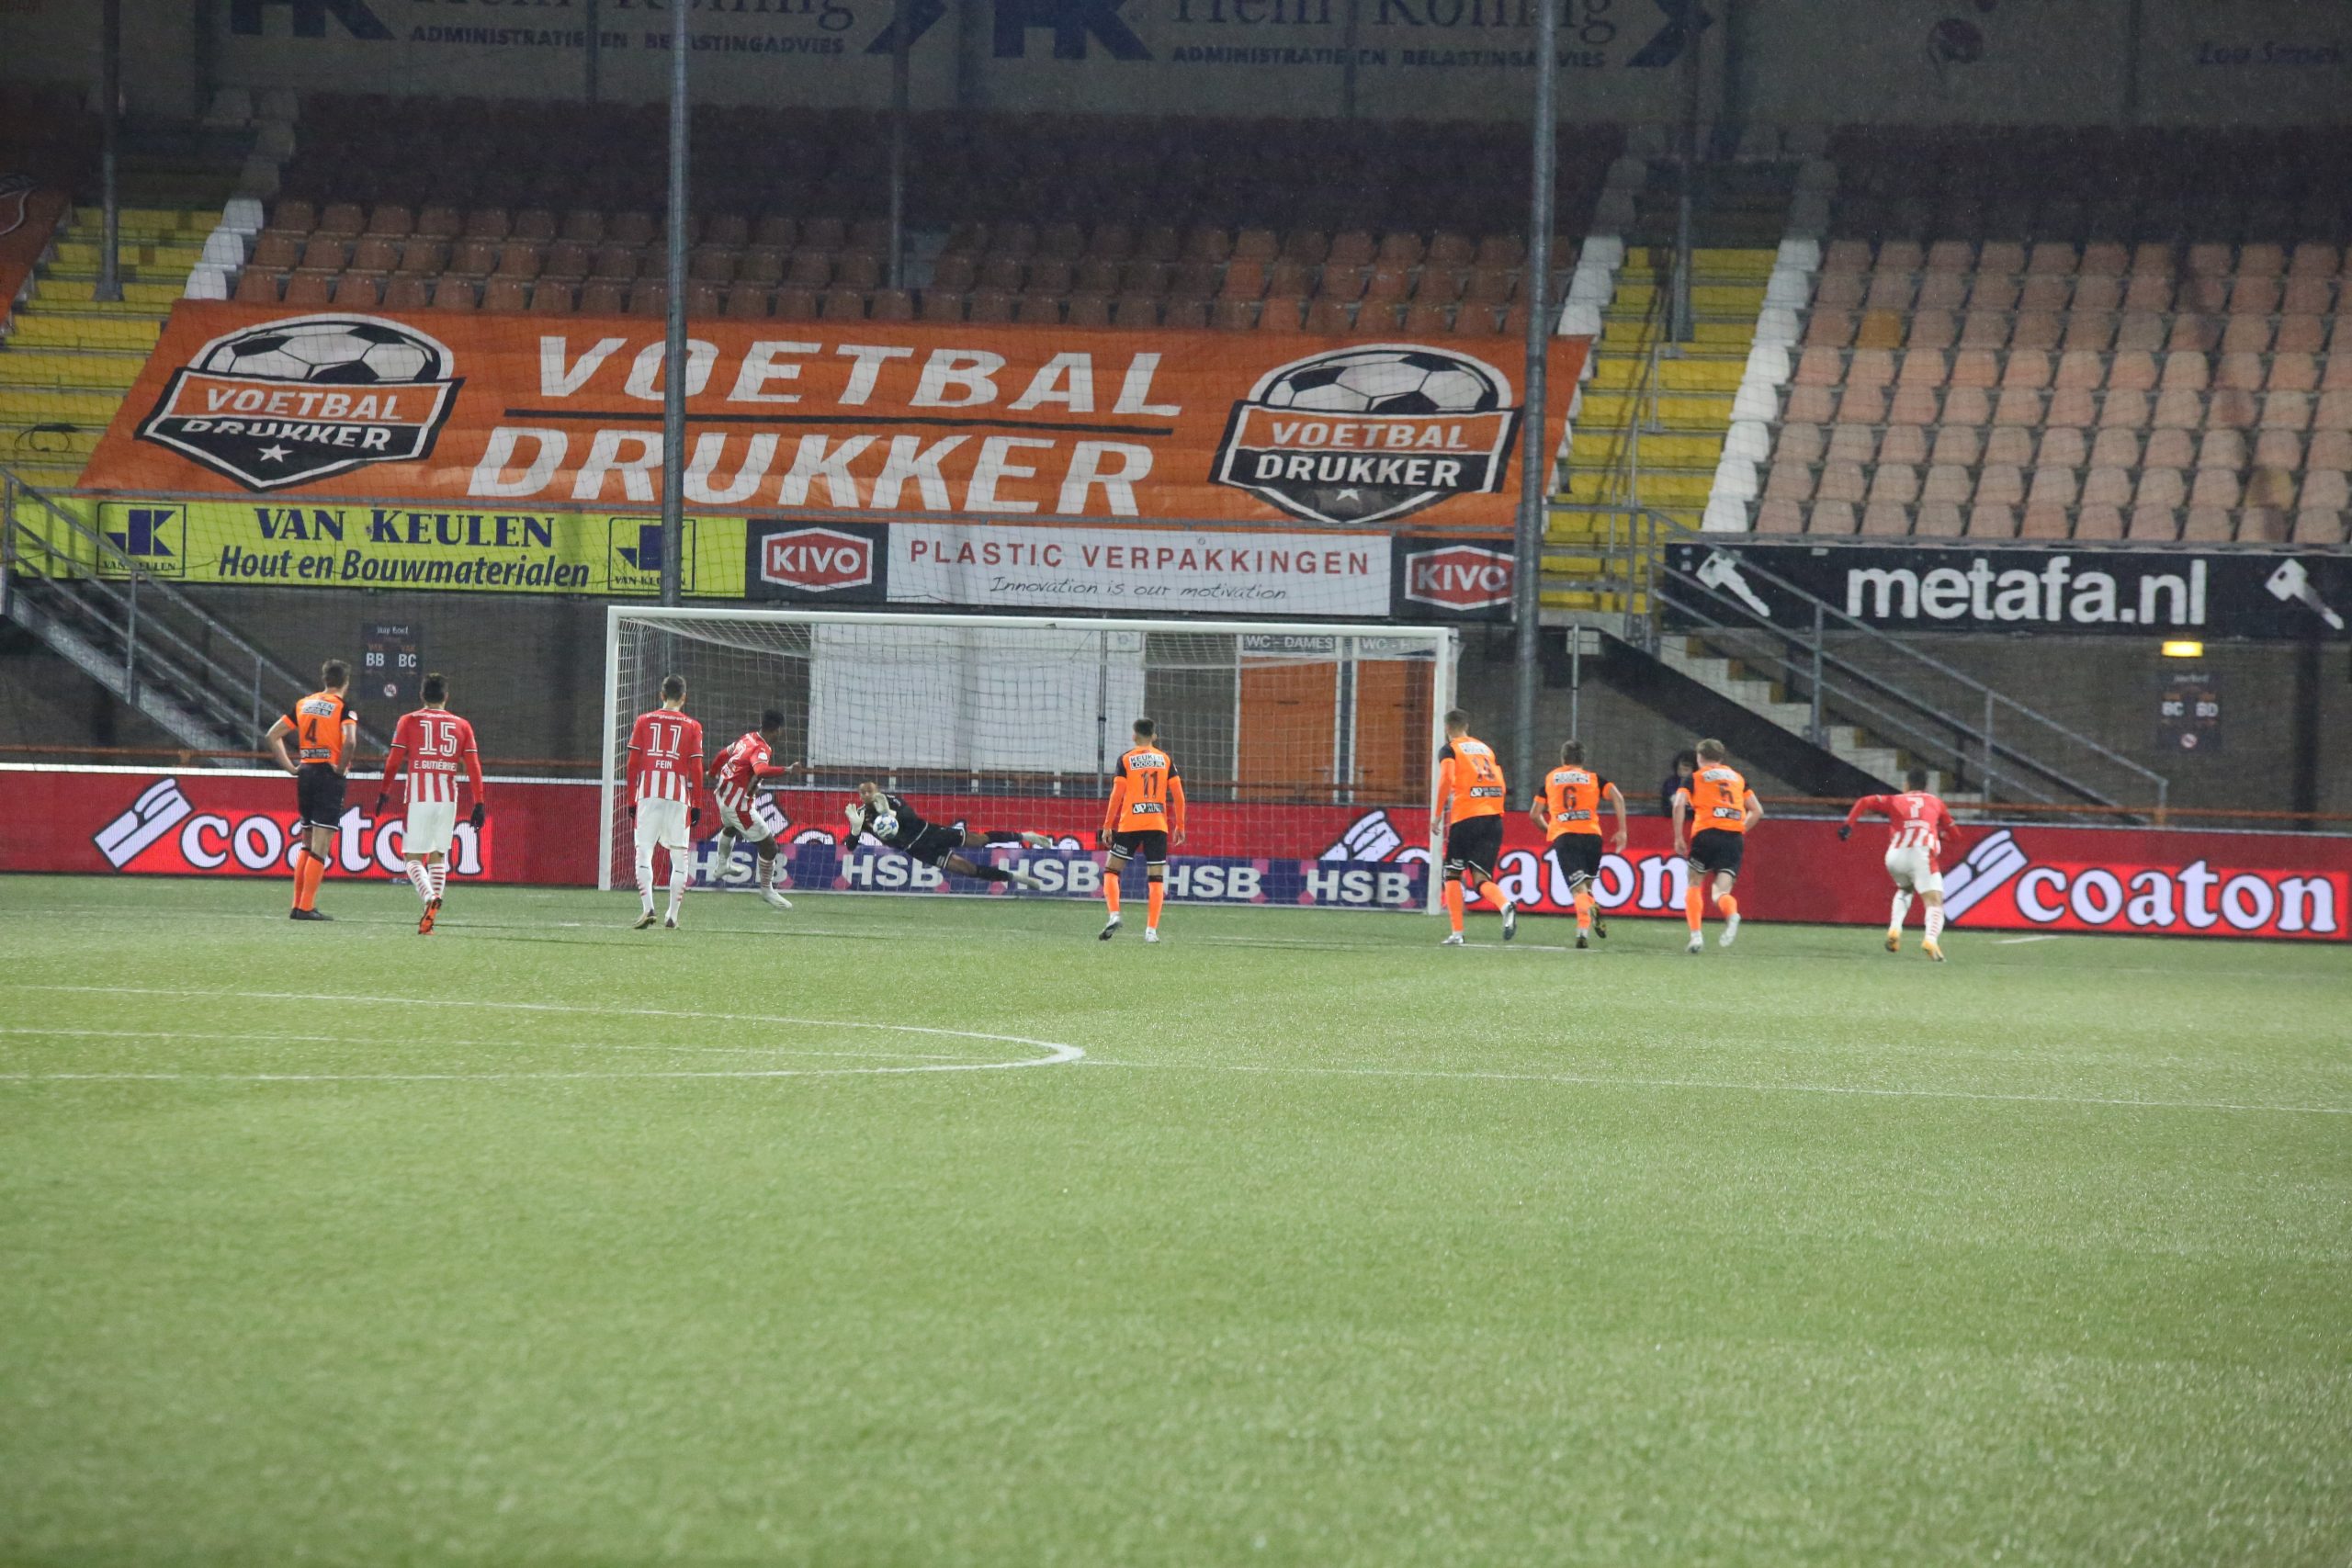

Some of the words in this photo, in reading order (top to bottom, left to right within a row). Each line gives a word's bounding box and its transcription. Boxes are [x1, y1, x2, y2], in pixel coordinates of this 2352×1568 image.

[411, 26, 586, 48] ADMINISTRATIE
[599, 32, 628, 48] EN
[644, 33, 843, 54] BESTINGADVIES
[1401, 50, 1605, 68] BELASTINGAVIES
[539, 336, 1182, 416] VOETBAL
[207, 388, 402, 420] VOETBAL
[180, 420, 392, 451] DRUKKER
[1272, 422, 1469, 448] VOETBAL
[467, 426, 1154, 517] DRUKKER
[1254, 455, 1462, 487] DRUKKER
[254, 507, 345, 542] VAN
[370, 510, 554, 548] KEULEN
[134, 561, 176, 572] EULEN
[219, 545, 290, 579] Hout
[298, 554, 334, 581] en
[341, 549, 590, 589] Bouwmaterialen
[773, 546, 861, 574] KIVO
[910, 540, 1063, 568] PLASTIC
[1081, 544, 1369, 576] VERPAKKINGEN
[615, 576, 638, 586] VAN
[640, 577, 686, 587] KEUN
[989, 576, 1099, 596] Innovation
[1106, 578, 1125, 597] is
[1134, 583, 1172, 598] our
[1180, 582, 1287, 600] motivation
[1417, 564, 1508, 593] KIVO
[1847, 556, 2207, 625] metafa.nl
[1246, 635, 1272, 649] WC
[1283, 637, 1334, 650] DAMES
[1361, 637, 1387, 650] WC
[366, 652, 385, 667] BB
[398, 653, 417, 669] BC
[305, 718, 318, 745] 4
[419, 719, 458, 758] 15
[647, 722, 683, 761] 11
[655, 760, 673, 770] FEIN
[1141, 771, 1159, 799] 11
[1563, 785, 1577, 811] 6
[1905, 795, 1925, 818] 7
[182, 805, 482, 875] coton
[687, 851, 790, 884] HSB
[842, 853, 944, 888] HSB
[998, 858, 1101, 892] HSB
[1161, 864, 1261, 899] HSB
[1306, 869, 1411, 904] HSB
[2015, 859, 2338, 933] coaton
